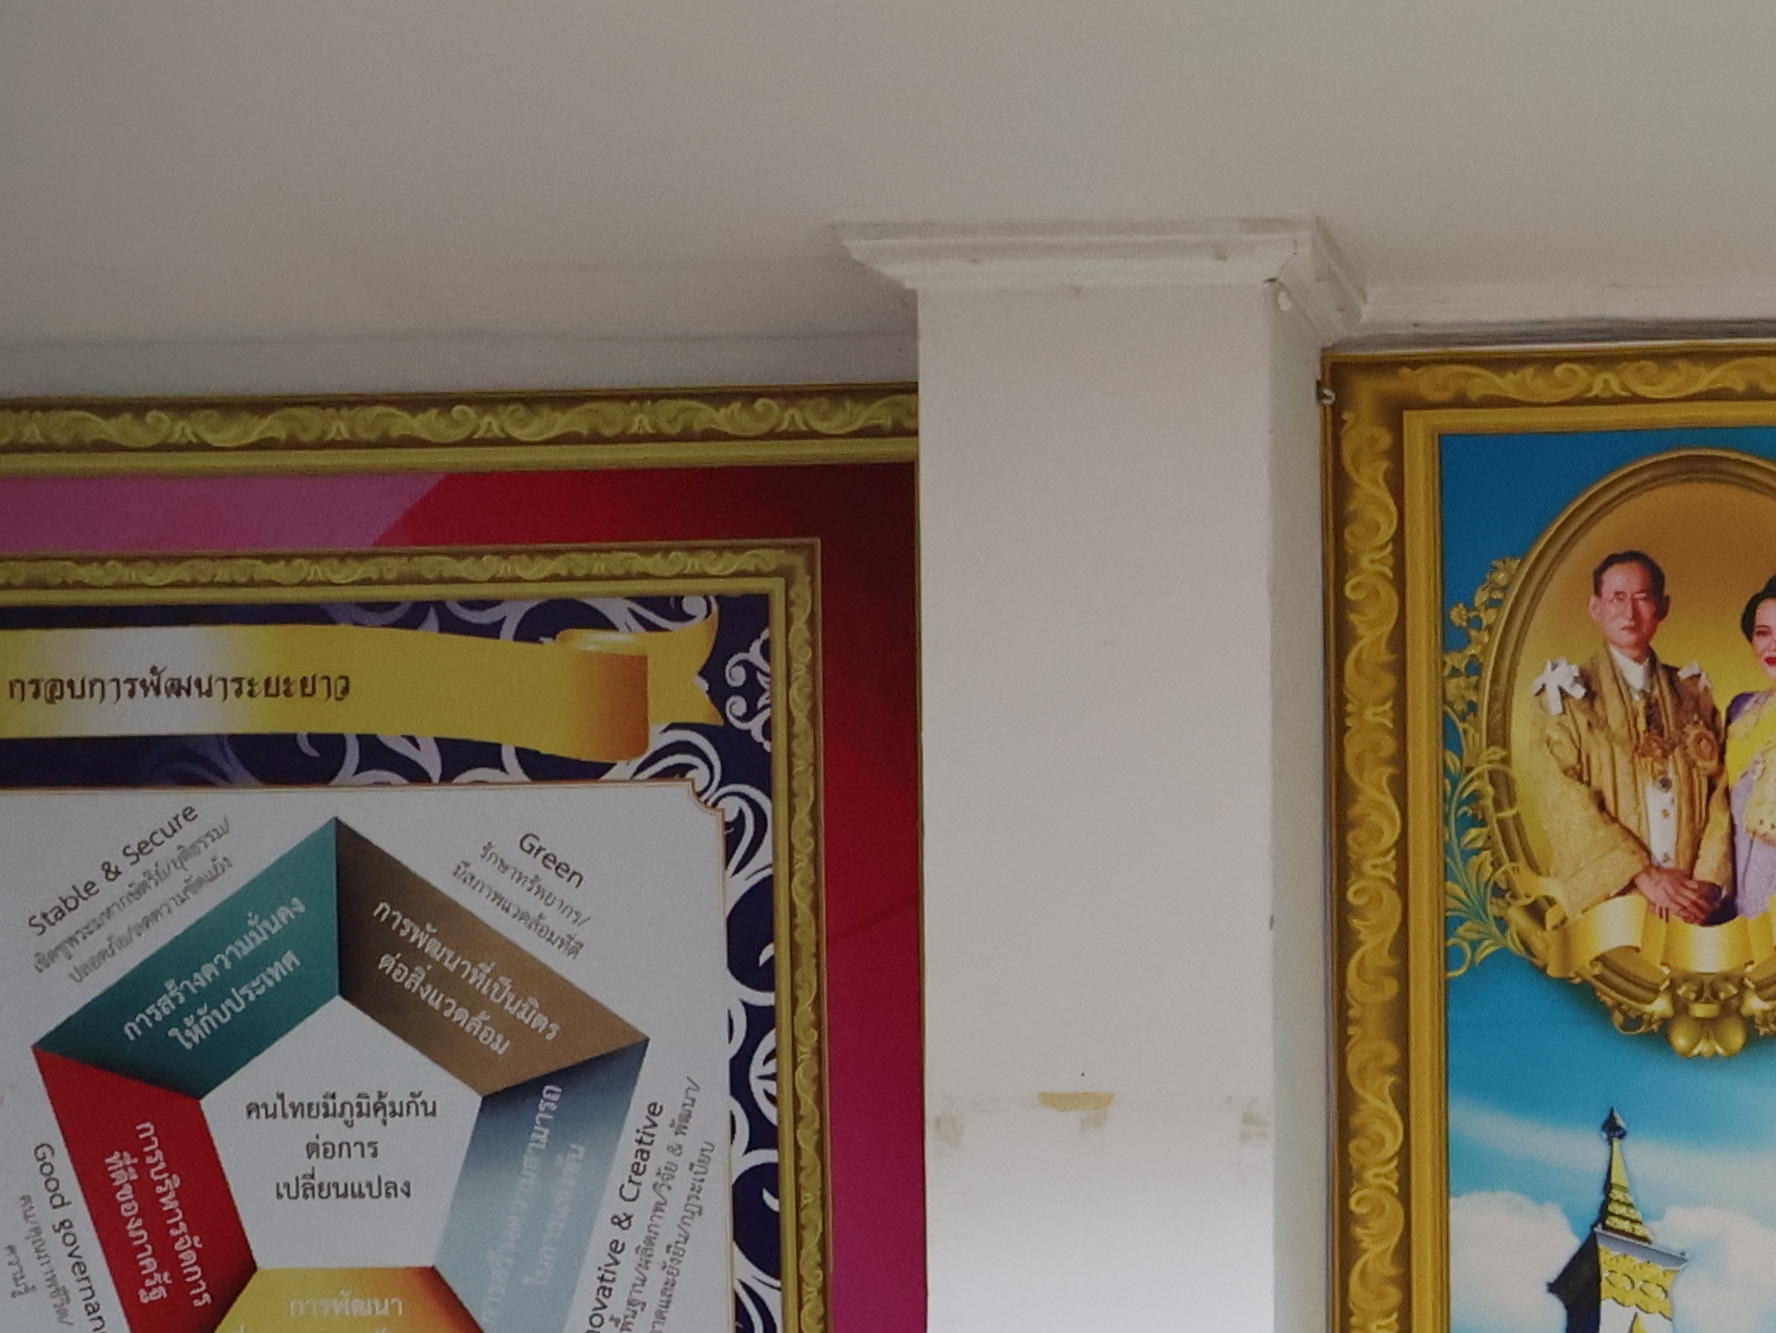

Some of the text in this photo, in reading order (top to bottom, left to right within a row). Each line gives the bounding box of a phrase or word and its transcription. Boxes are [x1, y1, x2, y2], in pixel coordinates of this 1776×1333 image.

[8, 664, 351, 704] กรอบการพัฒนาระยะยาว
[28, 804, 199, 936] Stable & Secure
[518, 832, 585, 890] Green
[122, 895, 307, 1042] การสร้างความมั่นคง
[168, 949, 301, 1050] ให้กับประเทศ
[372, 900, 561, 1041] การพัฒนาที่เป็นมิตร
[377, 951, 512, 1056] ต่อสิ่งแวดล้อม
[245, 1090, 438, 1129] คนไทยมีภูมิคุ้มกัน
[305, 1133, 379, 1160] ต่อการ
[619, 1100, 665, 1204] Creative
[33, 1142, 73, 1210] Good
[135, 1121, 213, 1307] การบริหารจัดการ
[275, 1166, 412, 1201] เปลี่ยนแปลง
[610, 1213, 634, 1231] &
[104, 1150, 173, 1304] ที่ดีของภาครัฐ
